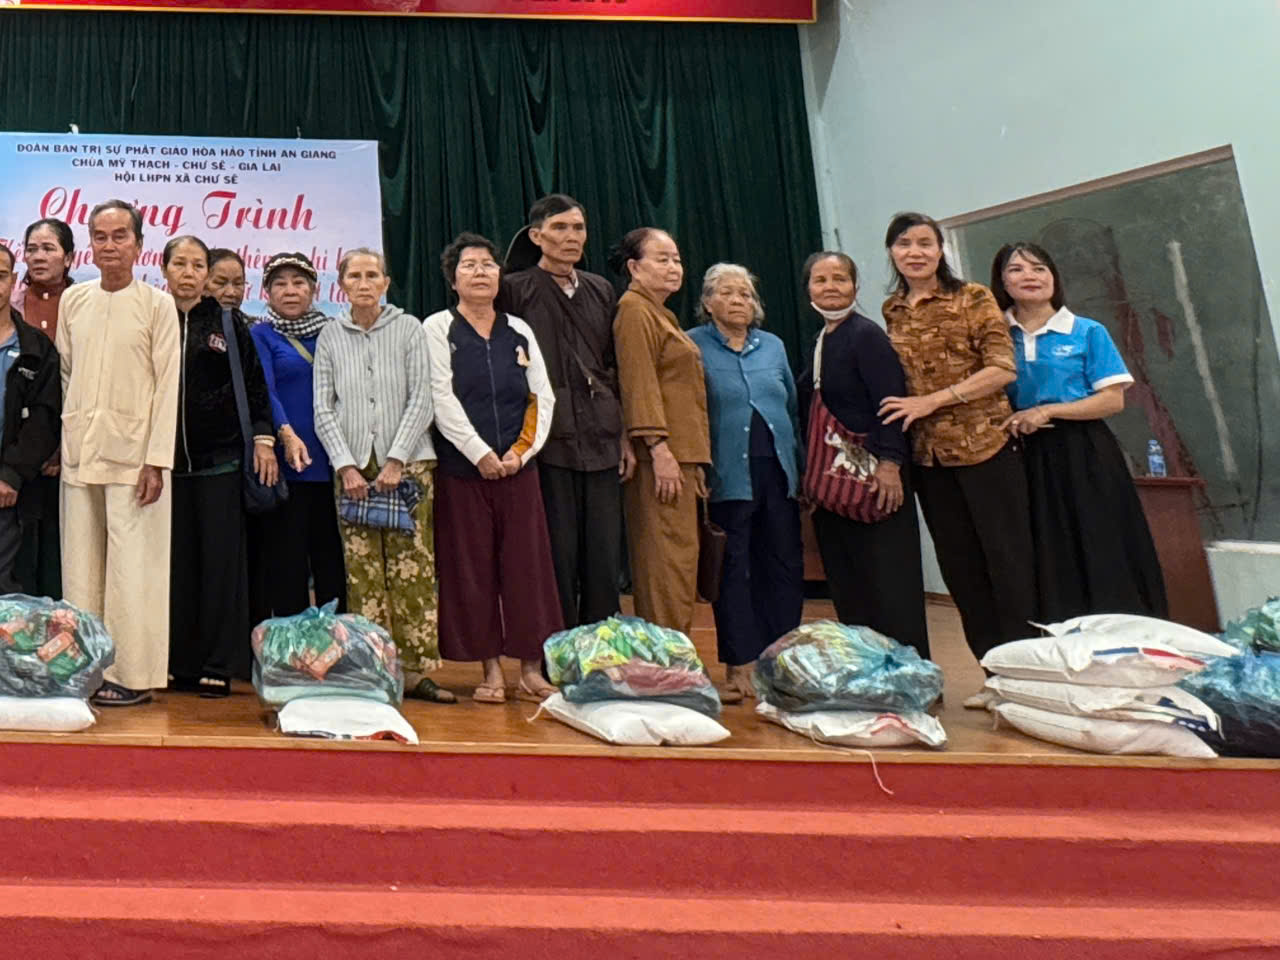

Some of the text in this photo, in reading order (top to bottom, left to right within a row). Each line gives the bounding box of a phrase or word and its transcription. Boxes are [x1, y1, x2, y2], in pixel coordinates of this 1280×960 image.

[53, 143, 78, 153] BAN
[81, 144, 101, 156] TRỊ
[105, 143, 122, 156] SỰ
[192, 146, 216, 157] HÒA
[280, 149, 297, 159] AN
[300, 149, 337, 160] GIANG
[71, 156, 104, 168] CHÙA
[182, 160, 208, 171] CHƯ
[238, 162, 259, 172] GIA
[262, 162, 282, 173] LAI
[114, 170, 135, 183] HỘI
[139, 172, 171, 183] LHPN
[194, 174, 220, 185] CHƯ
[40, 186, 318, 237] Chng Trình
